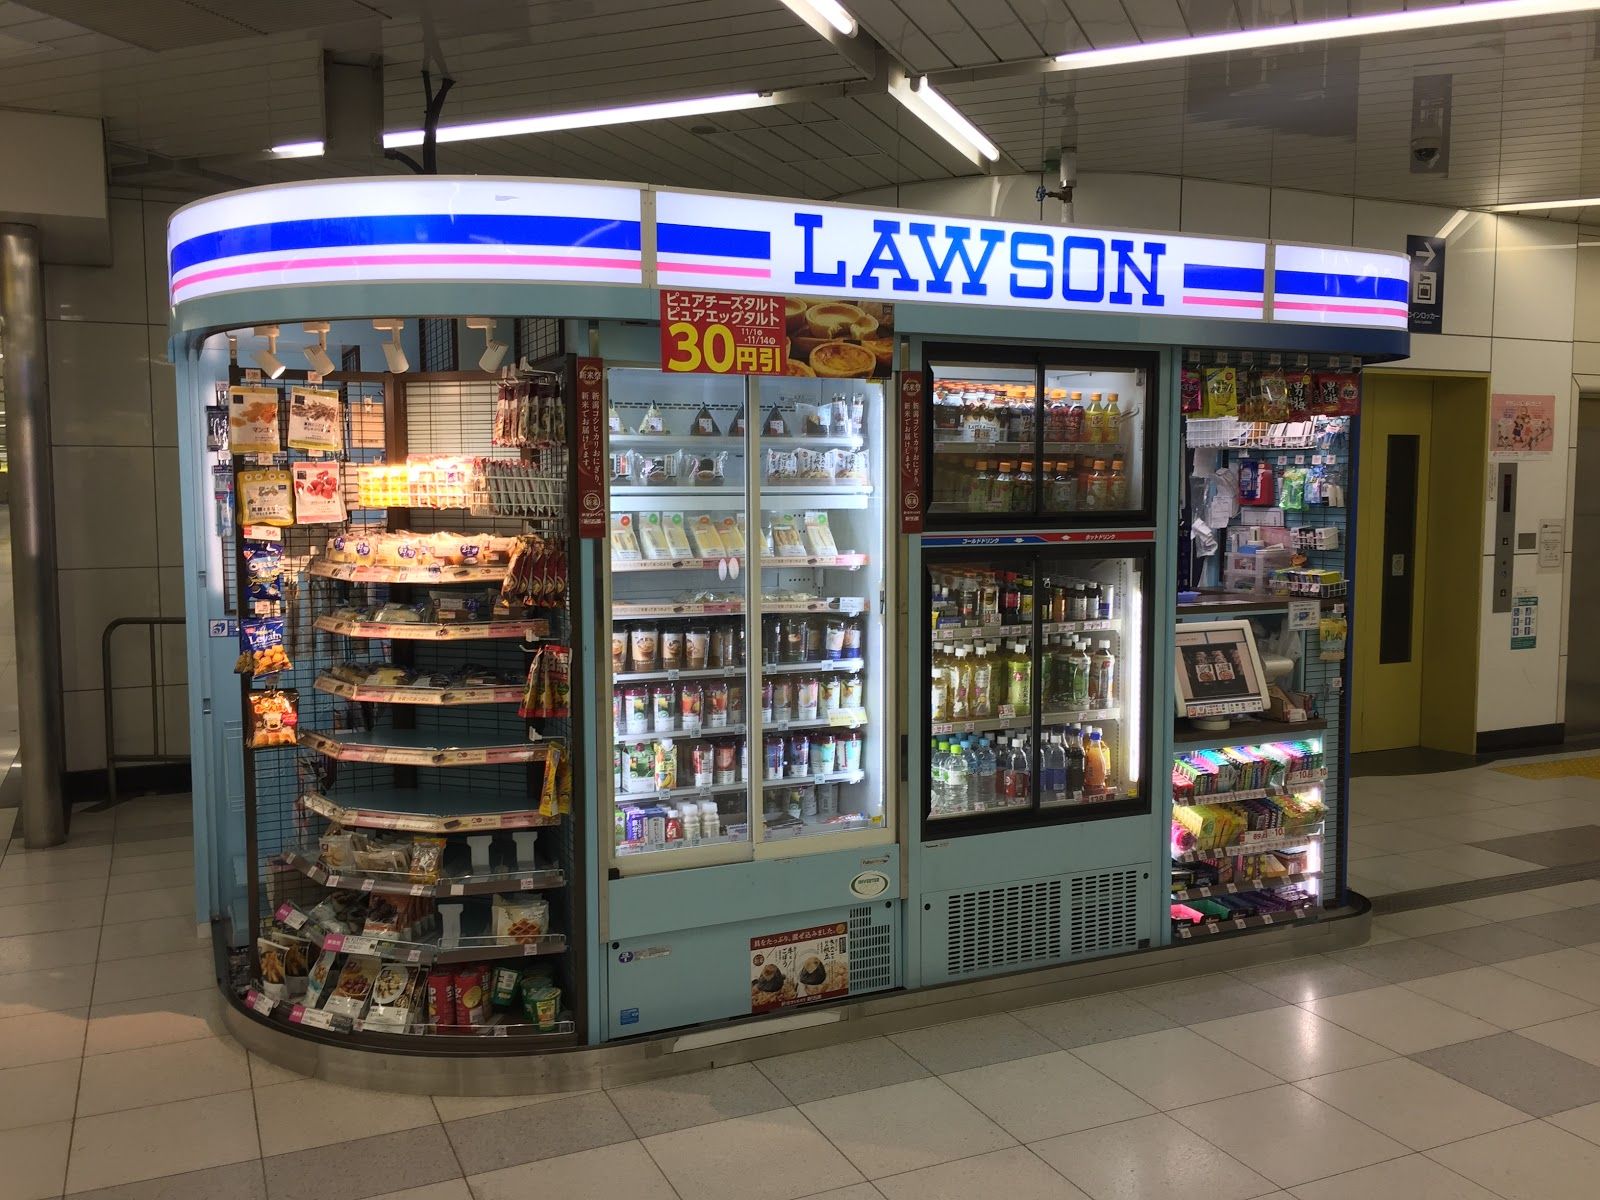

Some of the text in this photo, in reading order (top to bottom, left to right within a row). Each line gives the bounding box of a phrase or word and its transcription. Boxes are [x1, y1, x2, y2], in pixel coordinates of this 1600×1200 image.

[794, 213, 1166, 306] LAWSON
[666, 293, 779, 312] ピュアチーズタルト
[667, 307, 780, 326] ピュアエッグタルト
[962, 537, 1000, 545] コールドドリンク
[1085, 533, 1116, 541] ホットドリンク
